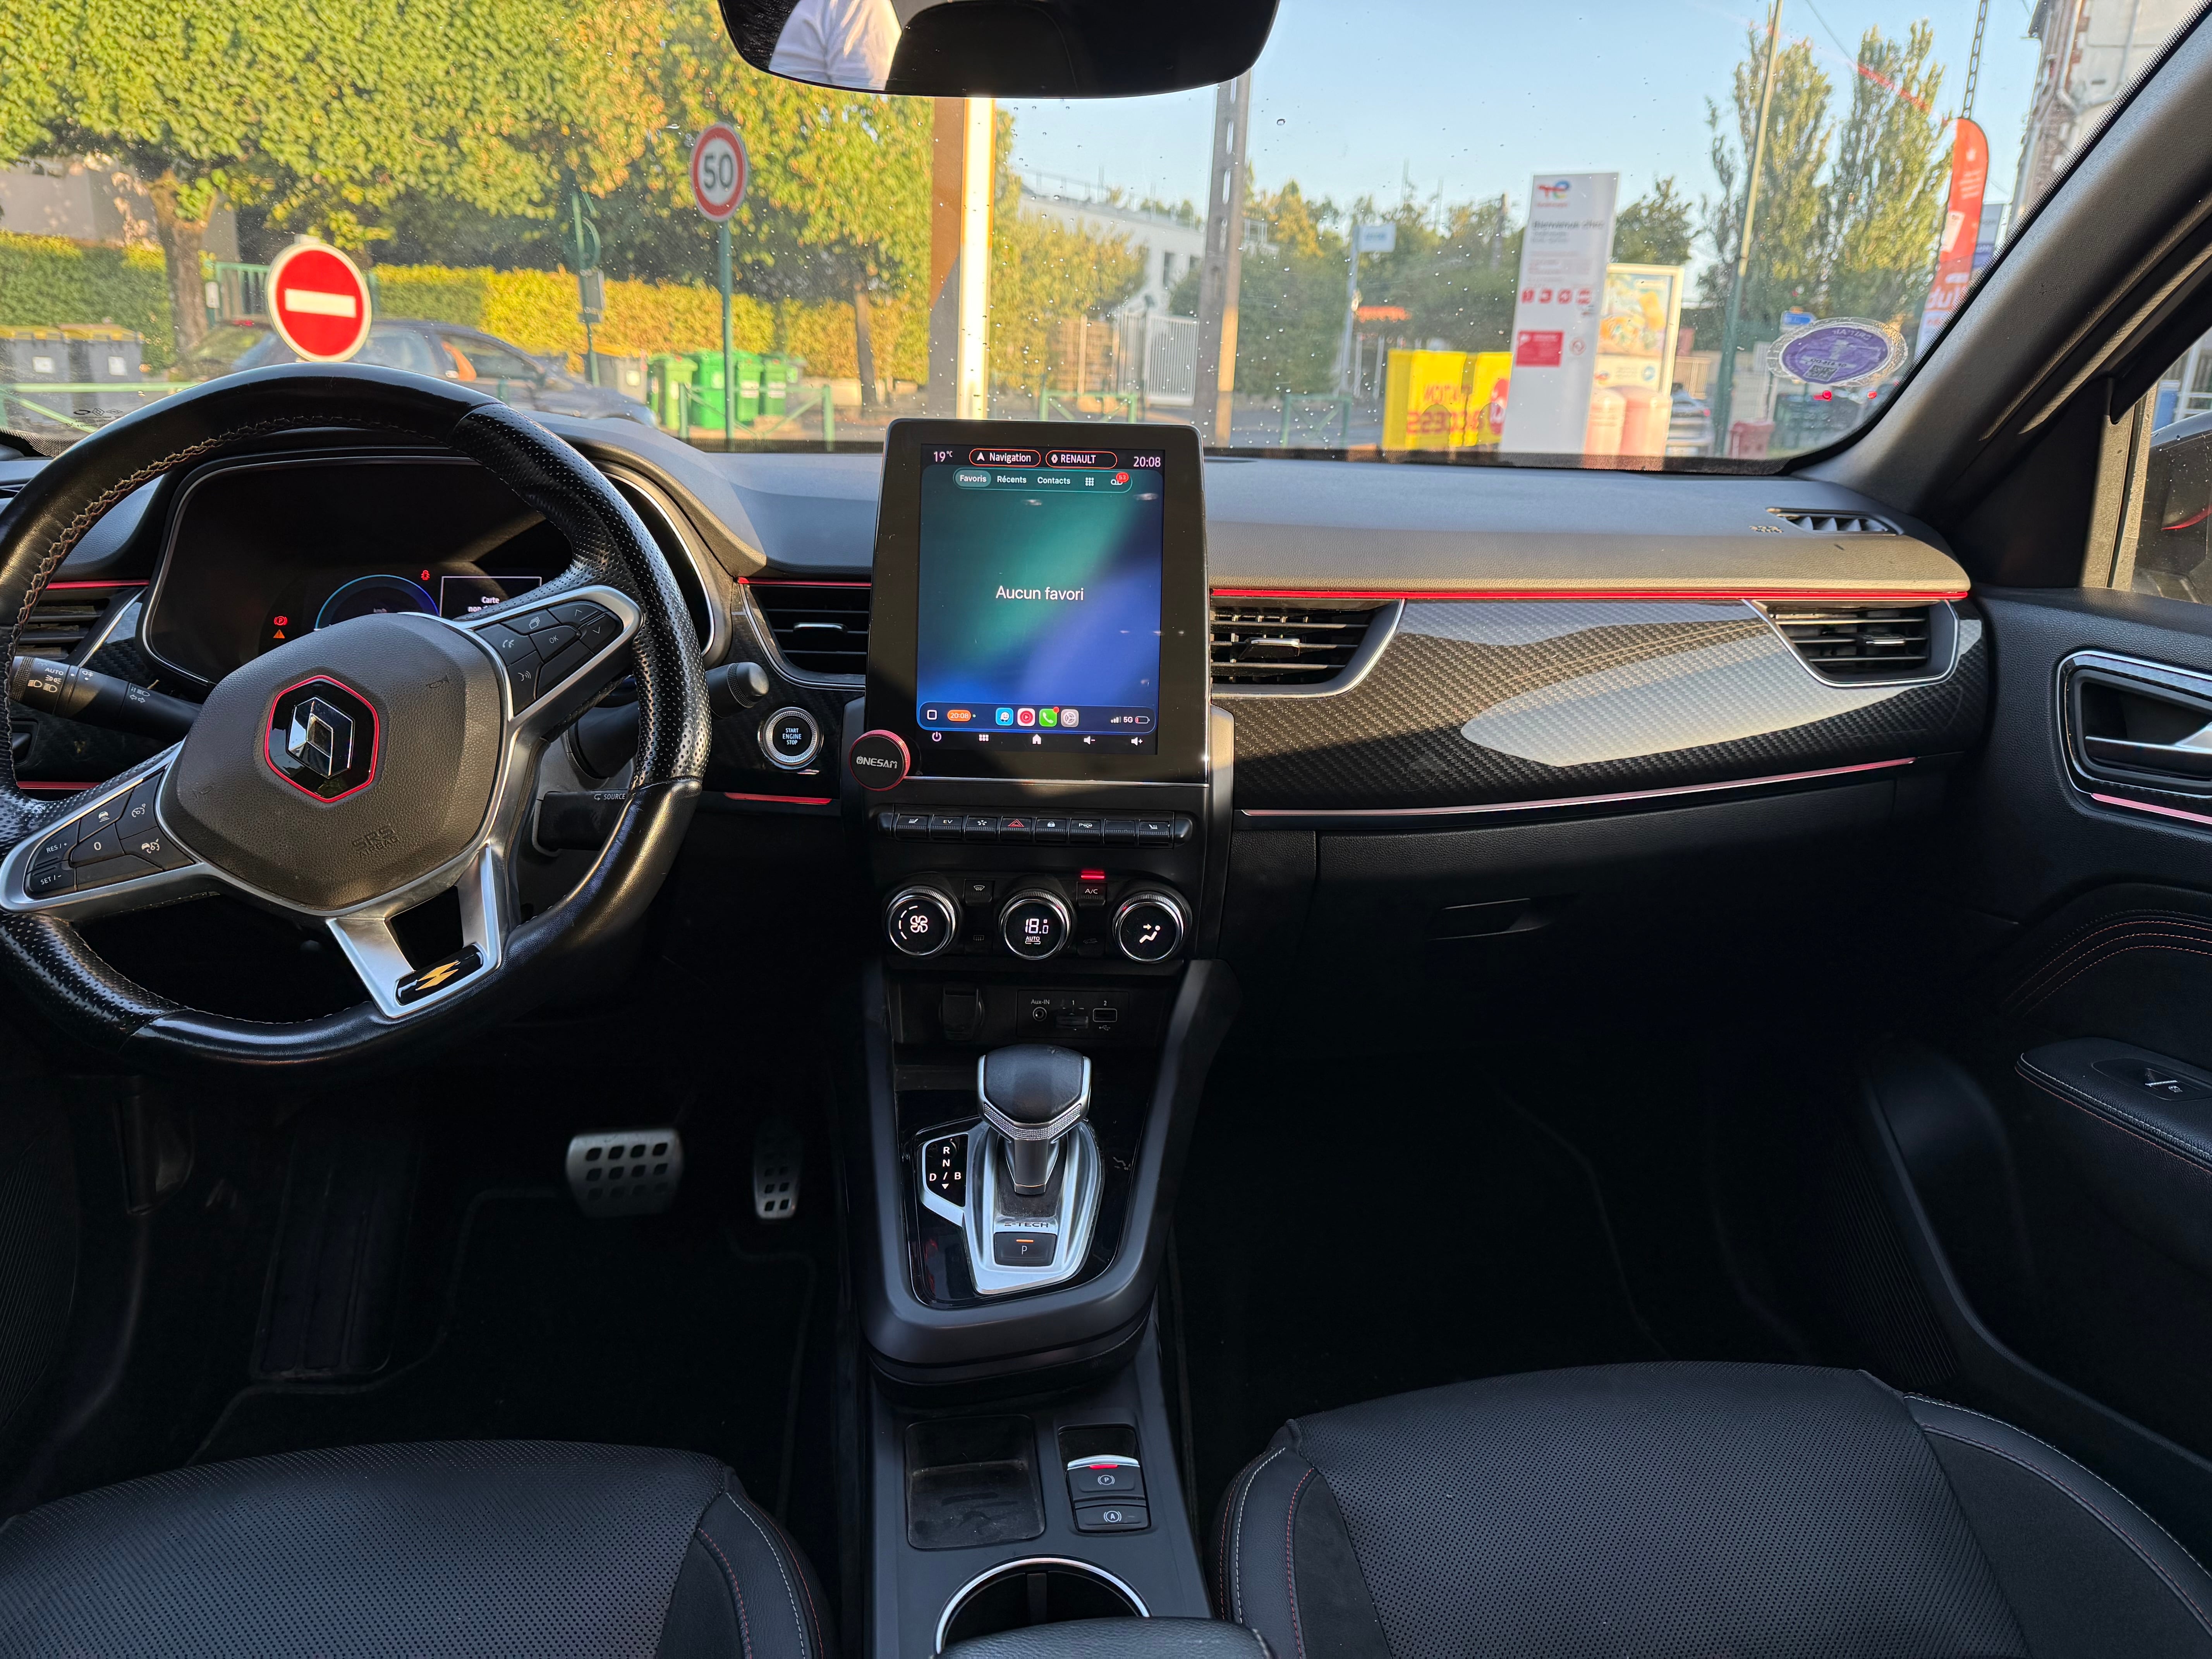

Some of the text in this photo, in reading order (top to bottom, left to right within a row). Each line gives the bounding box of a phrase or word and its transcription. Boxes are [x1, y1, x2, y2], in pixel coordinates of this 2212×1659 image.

[704, 154, 733, 189] 50
[989, 452, 1031, 464] Navigation
[1060, 454, 1096, 464] RENAULT
[1133, 457, 1161, 467] 20:08
[960, 474, 987, 483] Favoris
[997, 475, 1027, 484] Récents
[996, 585, 1084, 600] Aucun favori
[549, 635, 558, 644] OK
[40, 877, 52, 885] SET
[943, 1159, 950, 1167] N
[929, 1173, 937, 1181] D
[954, 1172, 961, 1180] B
[1022, 1245, 1027, 1255] P
